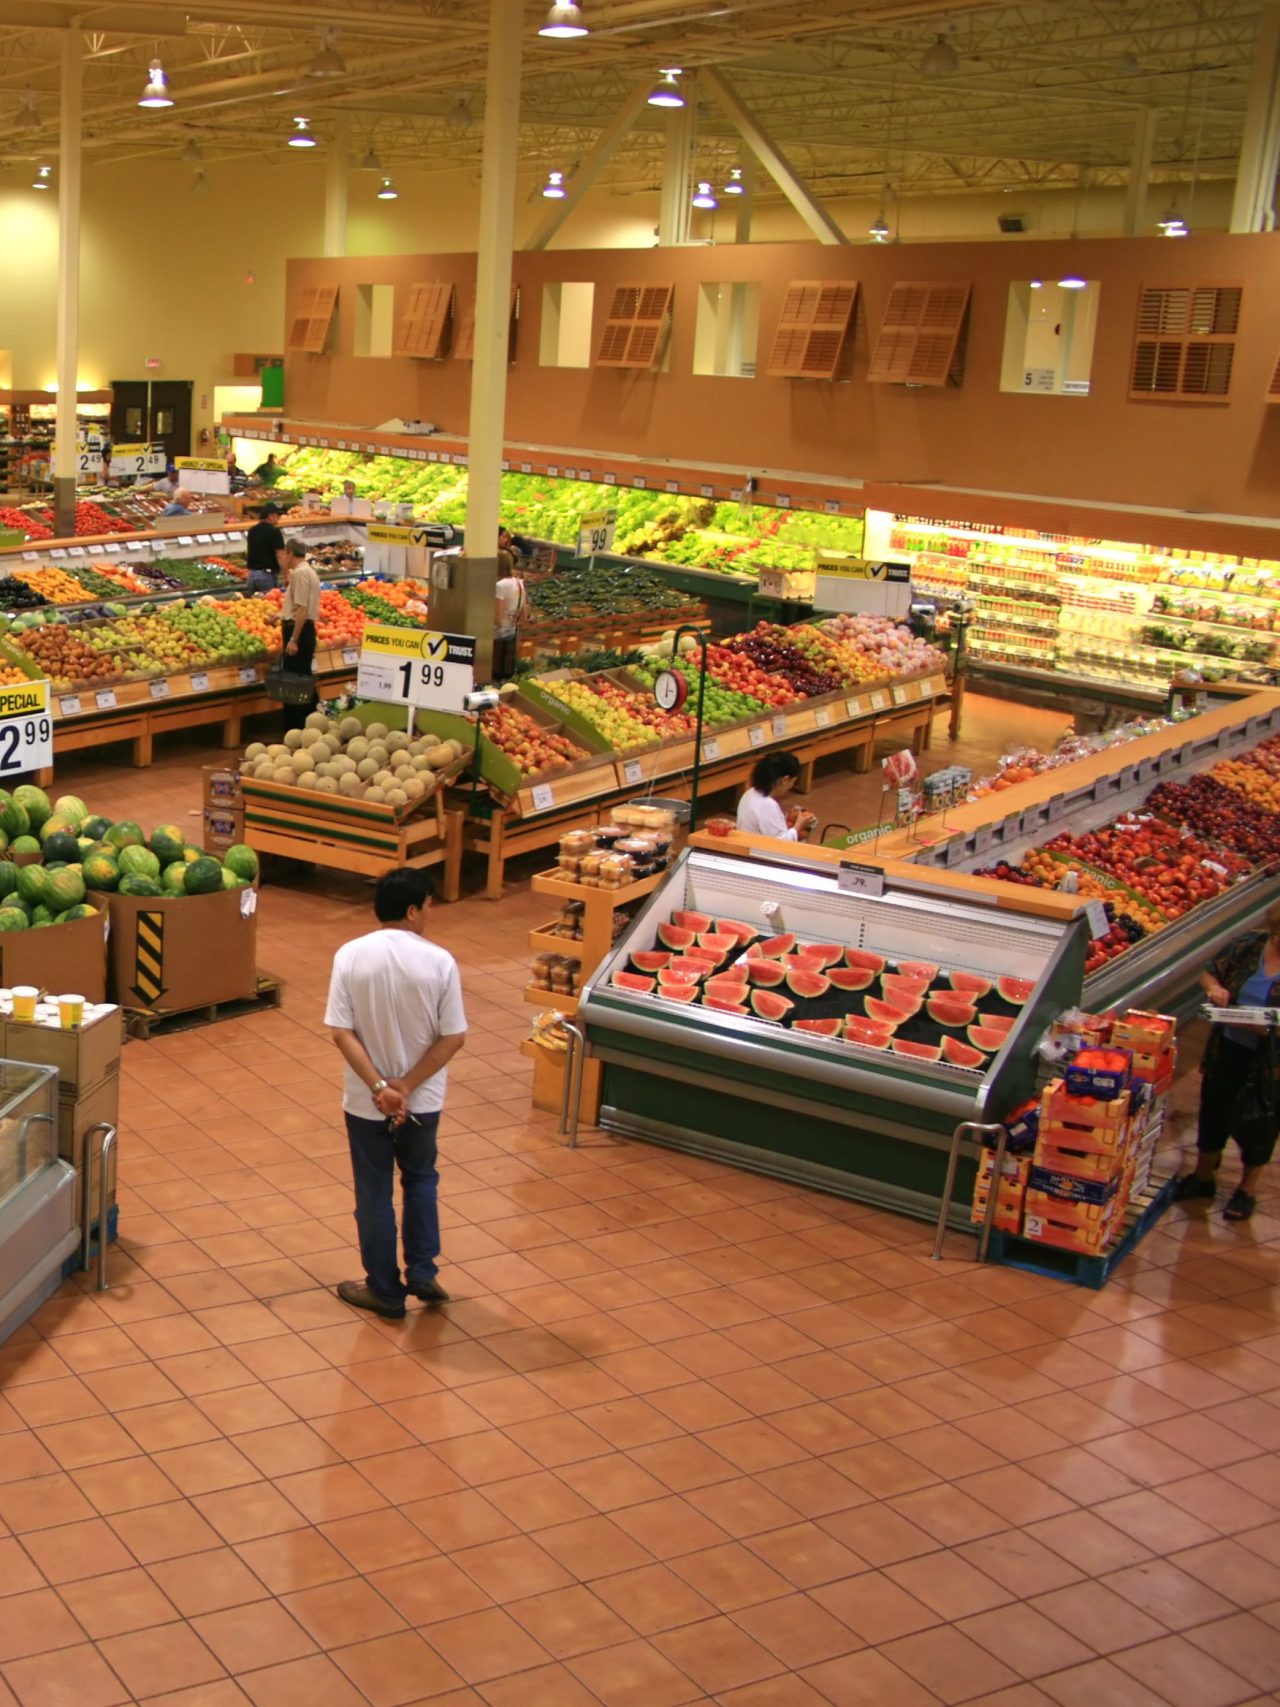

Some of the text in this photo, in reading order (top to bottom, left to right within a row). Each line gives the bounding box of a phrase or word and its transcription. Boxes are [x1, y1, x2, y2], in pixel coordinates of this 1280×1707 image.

[1024, 373, 1033, 386] 5
[365, 634, 391, 646] PRICES
[391, 638, 405, 648] YOU
[405, 640, 420, 650] CAN
[399, 661, 412, 698] 1
[846, 825, 892, 844] organic
[1028, 1219, 1040, 1233] 2
